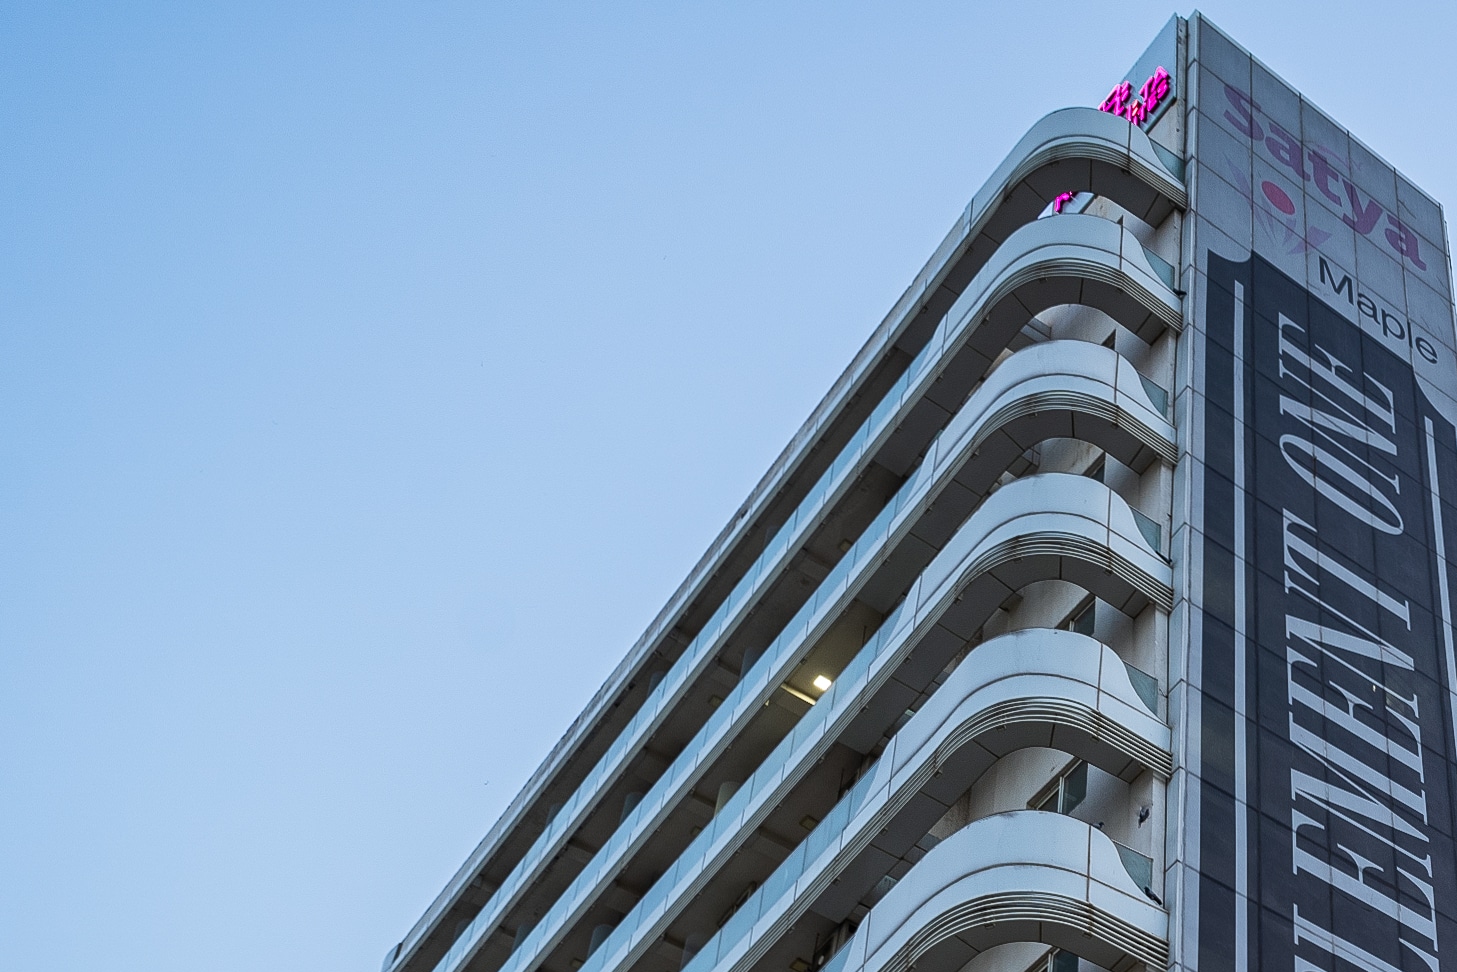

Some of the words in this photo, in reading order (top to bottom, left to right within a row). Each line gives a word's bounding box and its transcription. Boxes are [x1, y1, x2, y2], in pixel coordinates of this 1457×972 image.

[1223, 84, 1427, 271] Satya
[1319, 256, 1438, 364] Maple
[1279, 312, 1404, 535] ONE
